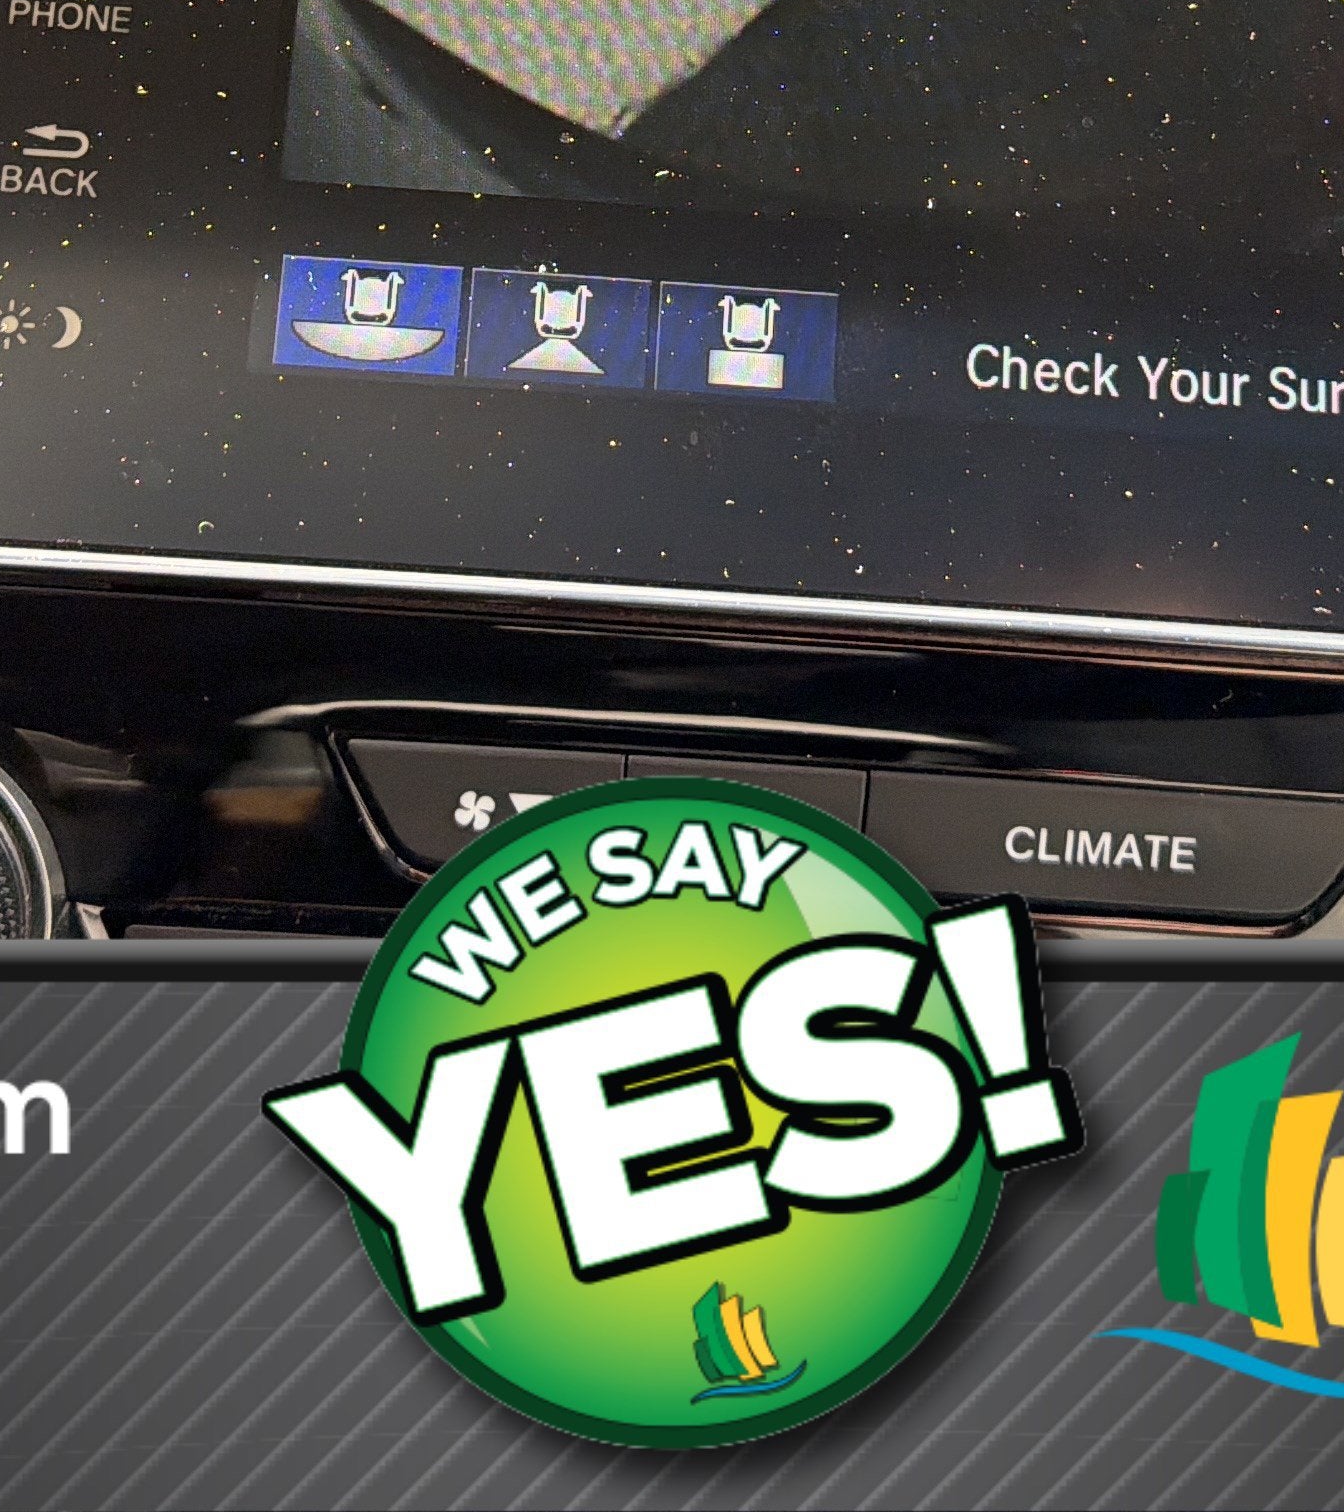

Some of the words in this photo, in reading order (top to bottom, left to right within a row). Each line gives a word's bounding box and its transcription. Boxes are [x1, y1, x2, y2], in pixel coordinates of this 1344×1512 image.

[8, 0, 133, 33] PHONE
[0, 164, 99, 199] BACK
[966, 342, 1120, 399] Check
[1137, 355, 1251, 409] Your
[1003, 824, 1199, 875] CLIMATE
